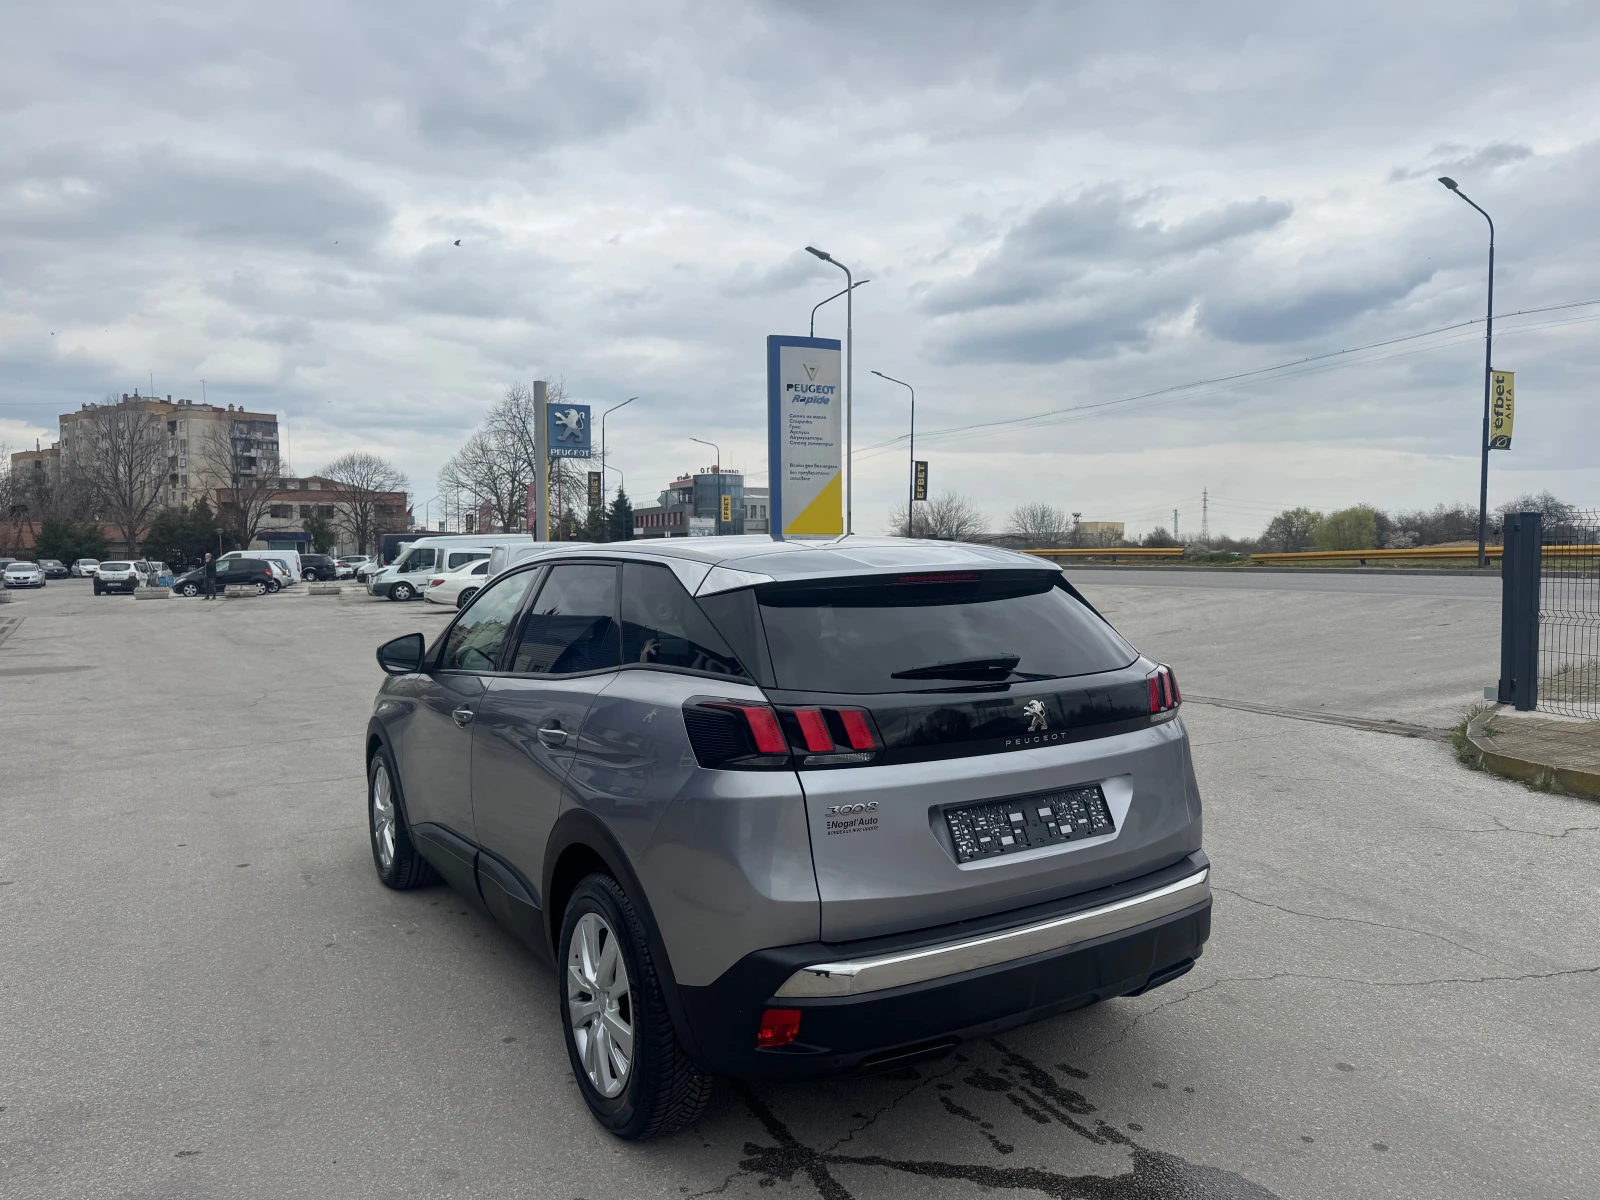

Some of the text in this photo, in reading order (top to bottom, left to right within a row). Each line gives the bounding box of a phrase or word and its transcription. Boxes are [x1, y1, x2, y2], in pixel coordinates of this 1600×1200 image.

[786, 383, 835, 395] PEUGEOT
[792, 394, 830, 405] Rapide
[1493, 375, 1505, 429] efbet
[550, 448, 590, 457] PEUGEOT
[917, 463, 925, 499] EFBET
[590, 474, 599, 505] EFBET
[1005, 732, 1067, 747] PEUGEOT
[825, 801, 879, 817] 3008
